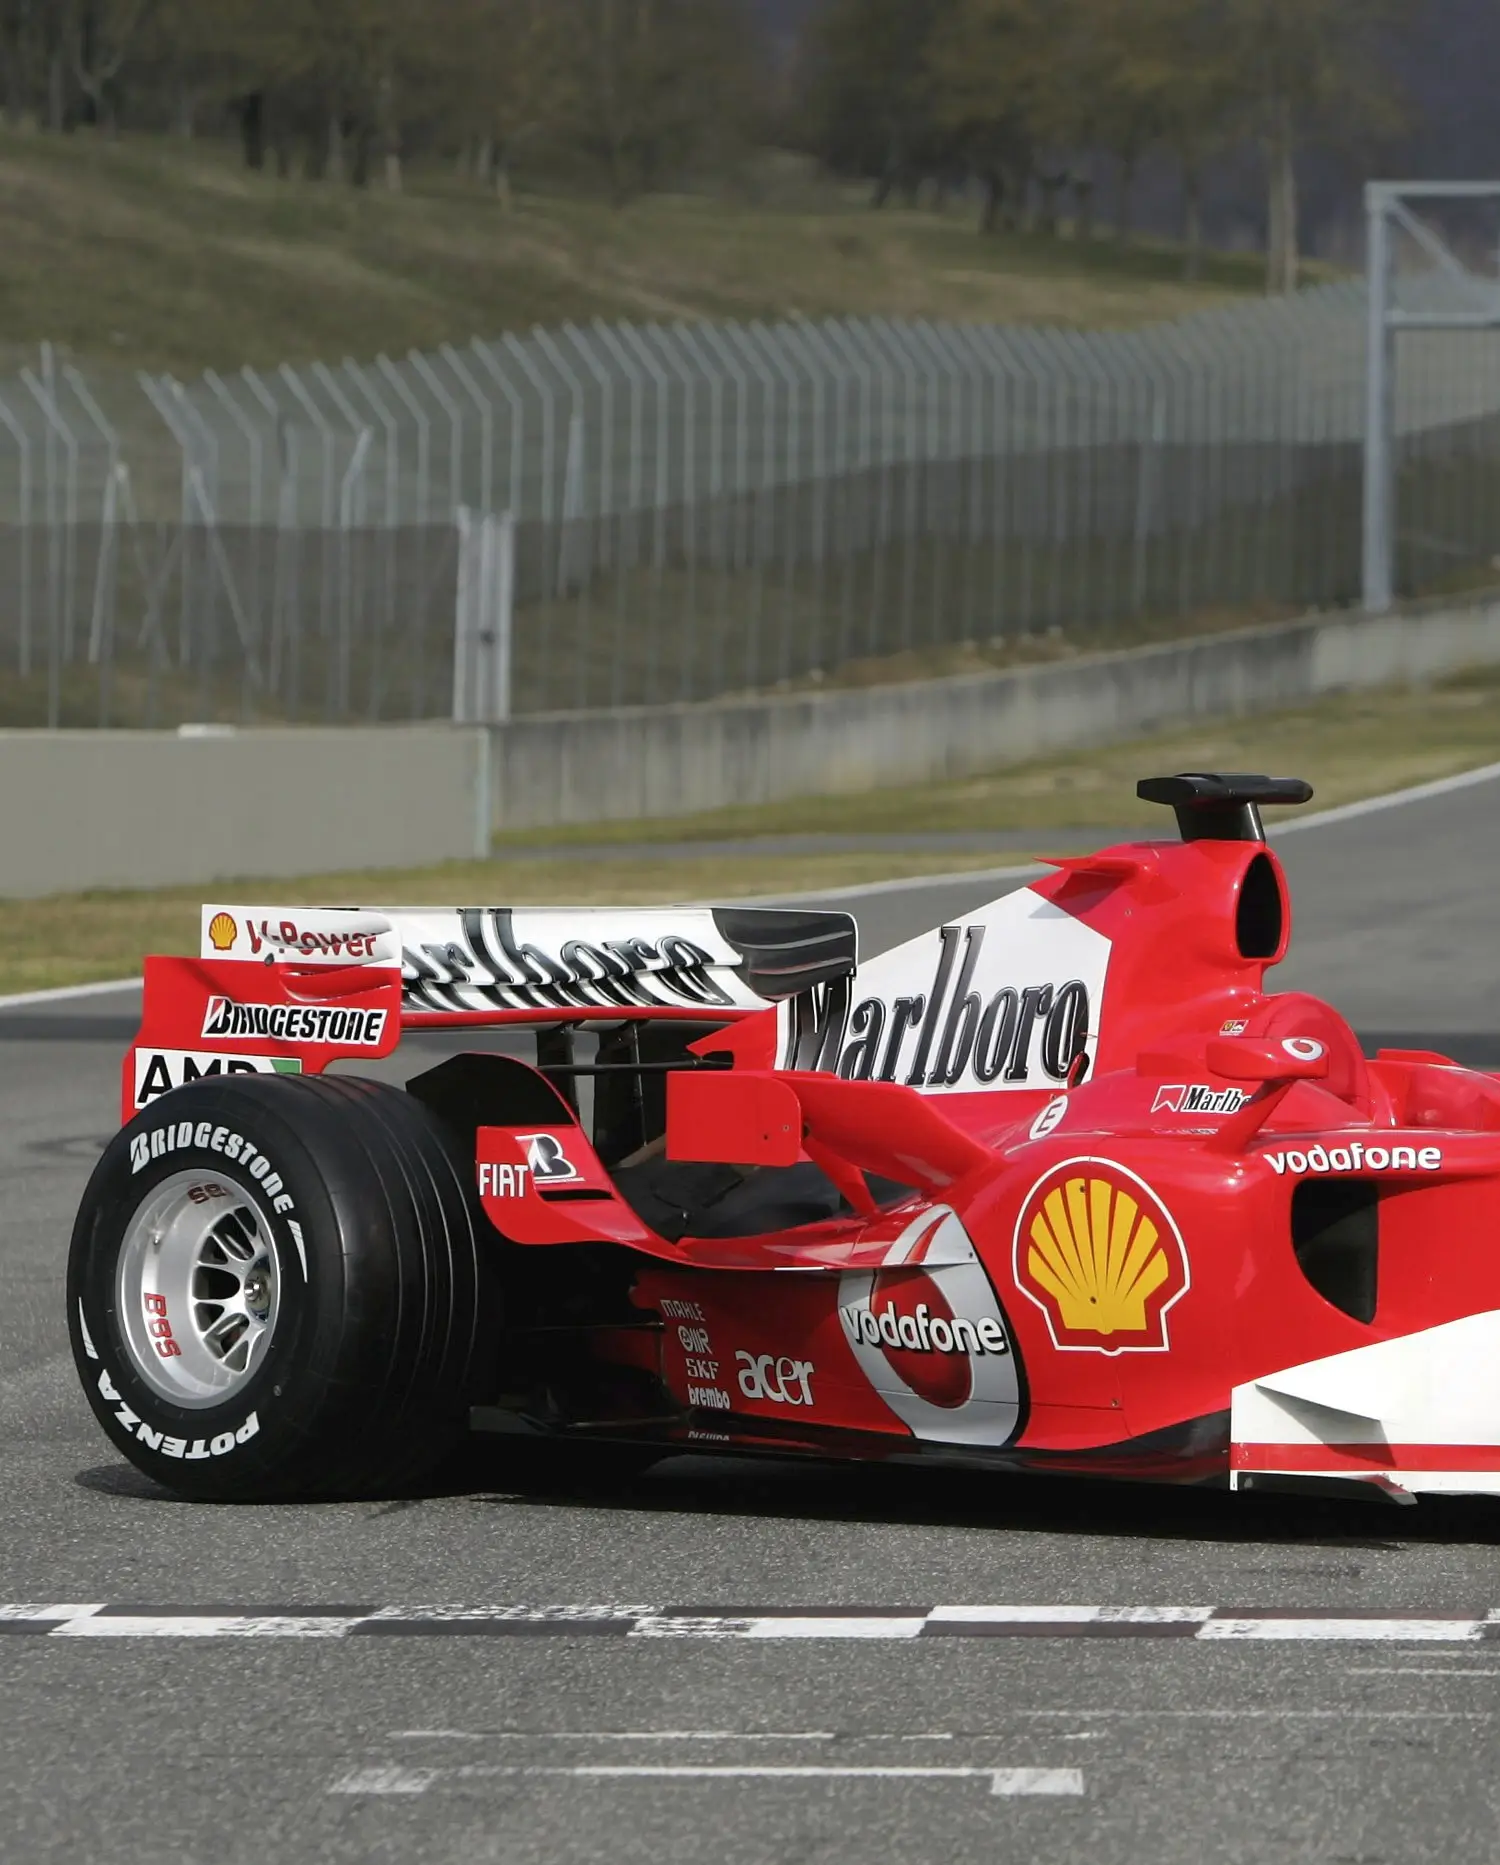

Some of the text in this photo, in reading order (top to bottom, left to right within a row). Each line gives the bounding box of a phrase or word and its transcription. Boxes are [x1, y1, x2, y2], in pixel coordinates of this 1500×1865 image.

[245, 919, 377, 957] V-Power
[204, 996, 384, 1042] BRIDGESTONE
[1183, 1086, 1250, 1113] Marlb
[130, 1121, 295, 1214] BRIDGESTONE
[1264, 1143, 1442, 1175] vodafone
[479, 1163, 529, 1197] FIAT
[144, 1293, 182, 1360] BBS
[660, 1300, 706, 1322] MAHLE
[841, 1304, 1006, 1354] vodafone
[686, 1358, 719, 1380] SKF
[735, 1350, 814, 1405] acer
[98, 1369, 260, 1459] POTENZA
[687, 1384, 731, 1409] brembo
